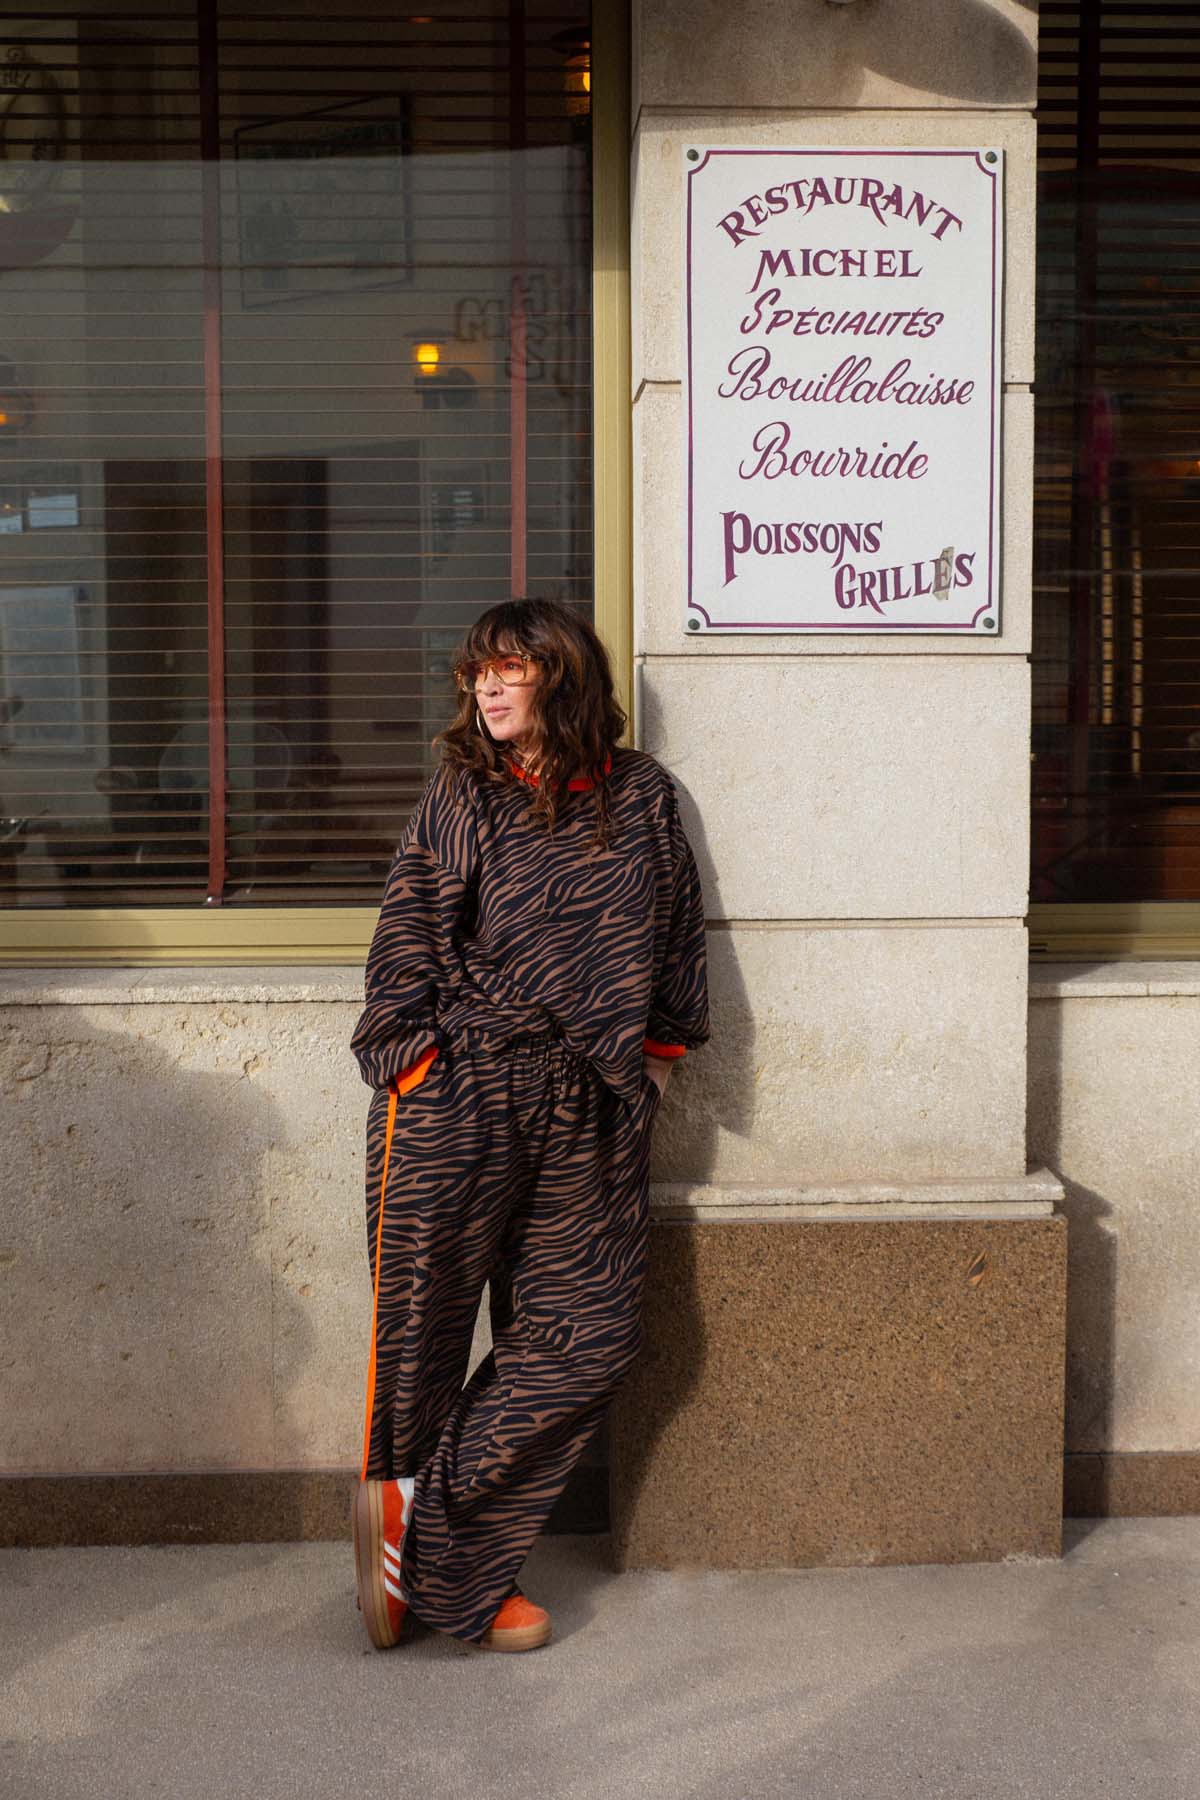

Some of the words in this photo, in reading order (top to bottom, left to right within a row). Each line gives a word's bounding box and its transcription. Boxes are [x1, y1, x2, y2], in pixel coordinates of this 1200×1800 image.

[715, 176, 963, 248] RESTAURANT
[745, 248, 923, 294] MICHEL
[739, 287, 945, 339] SPÉCIALITÉS
[717, 345, 975, 406] Bouillabaisse
[738, 420, 929, 480] Bourride
[719, 510, 883, 588] POISSONS
